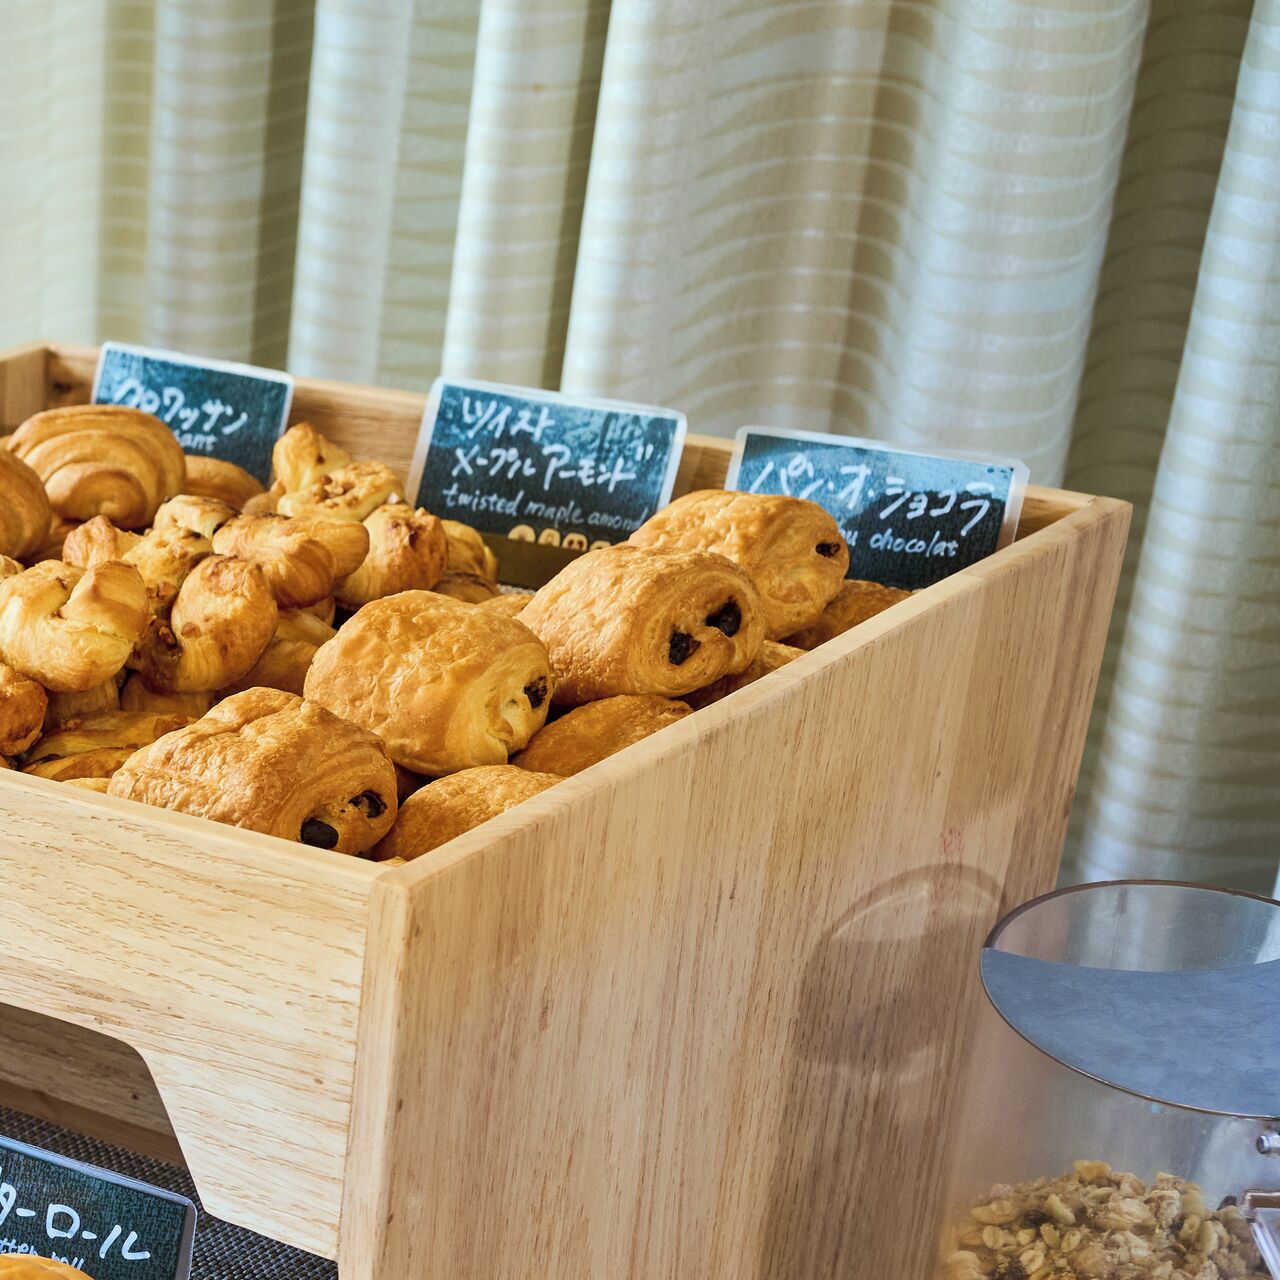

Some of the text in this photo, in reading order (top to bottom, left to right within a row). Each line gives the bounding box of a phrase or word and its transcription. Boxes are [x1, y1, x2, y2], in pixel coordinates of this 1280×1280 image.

[461, 396, 556, 441] ツイスト
[442, 481, 525, 516] twisted
[524, 499, 584, 529] maple
[869, 527, 959, 558] chocolat
